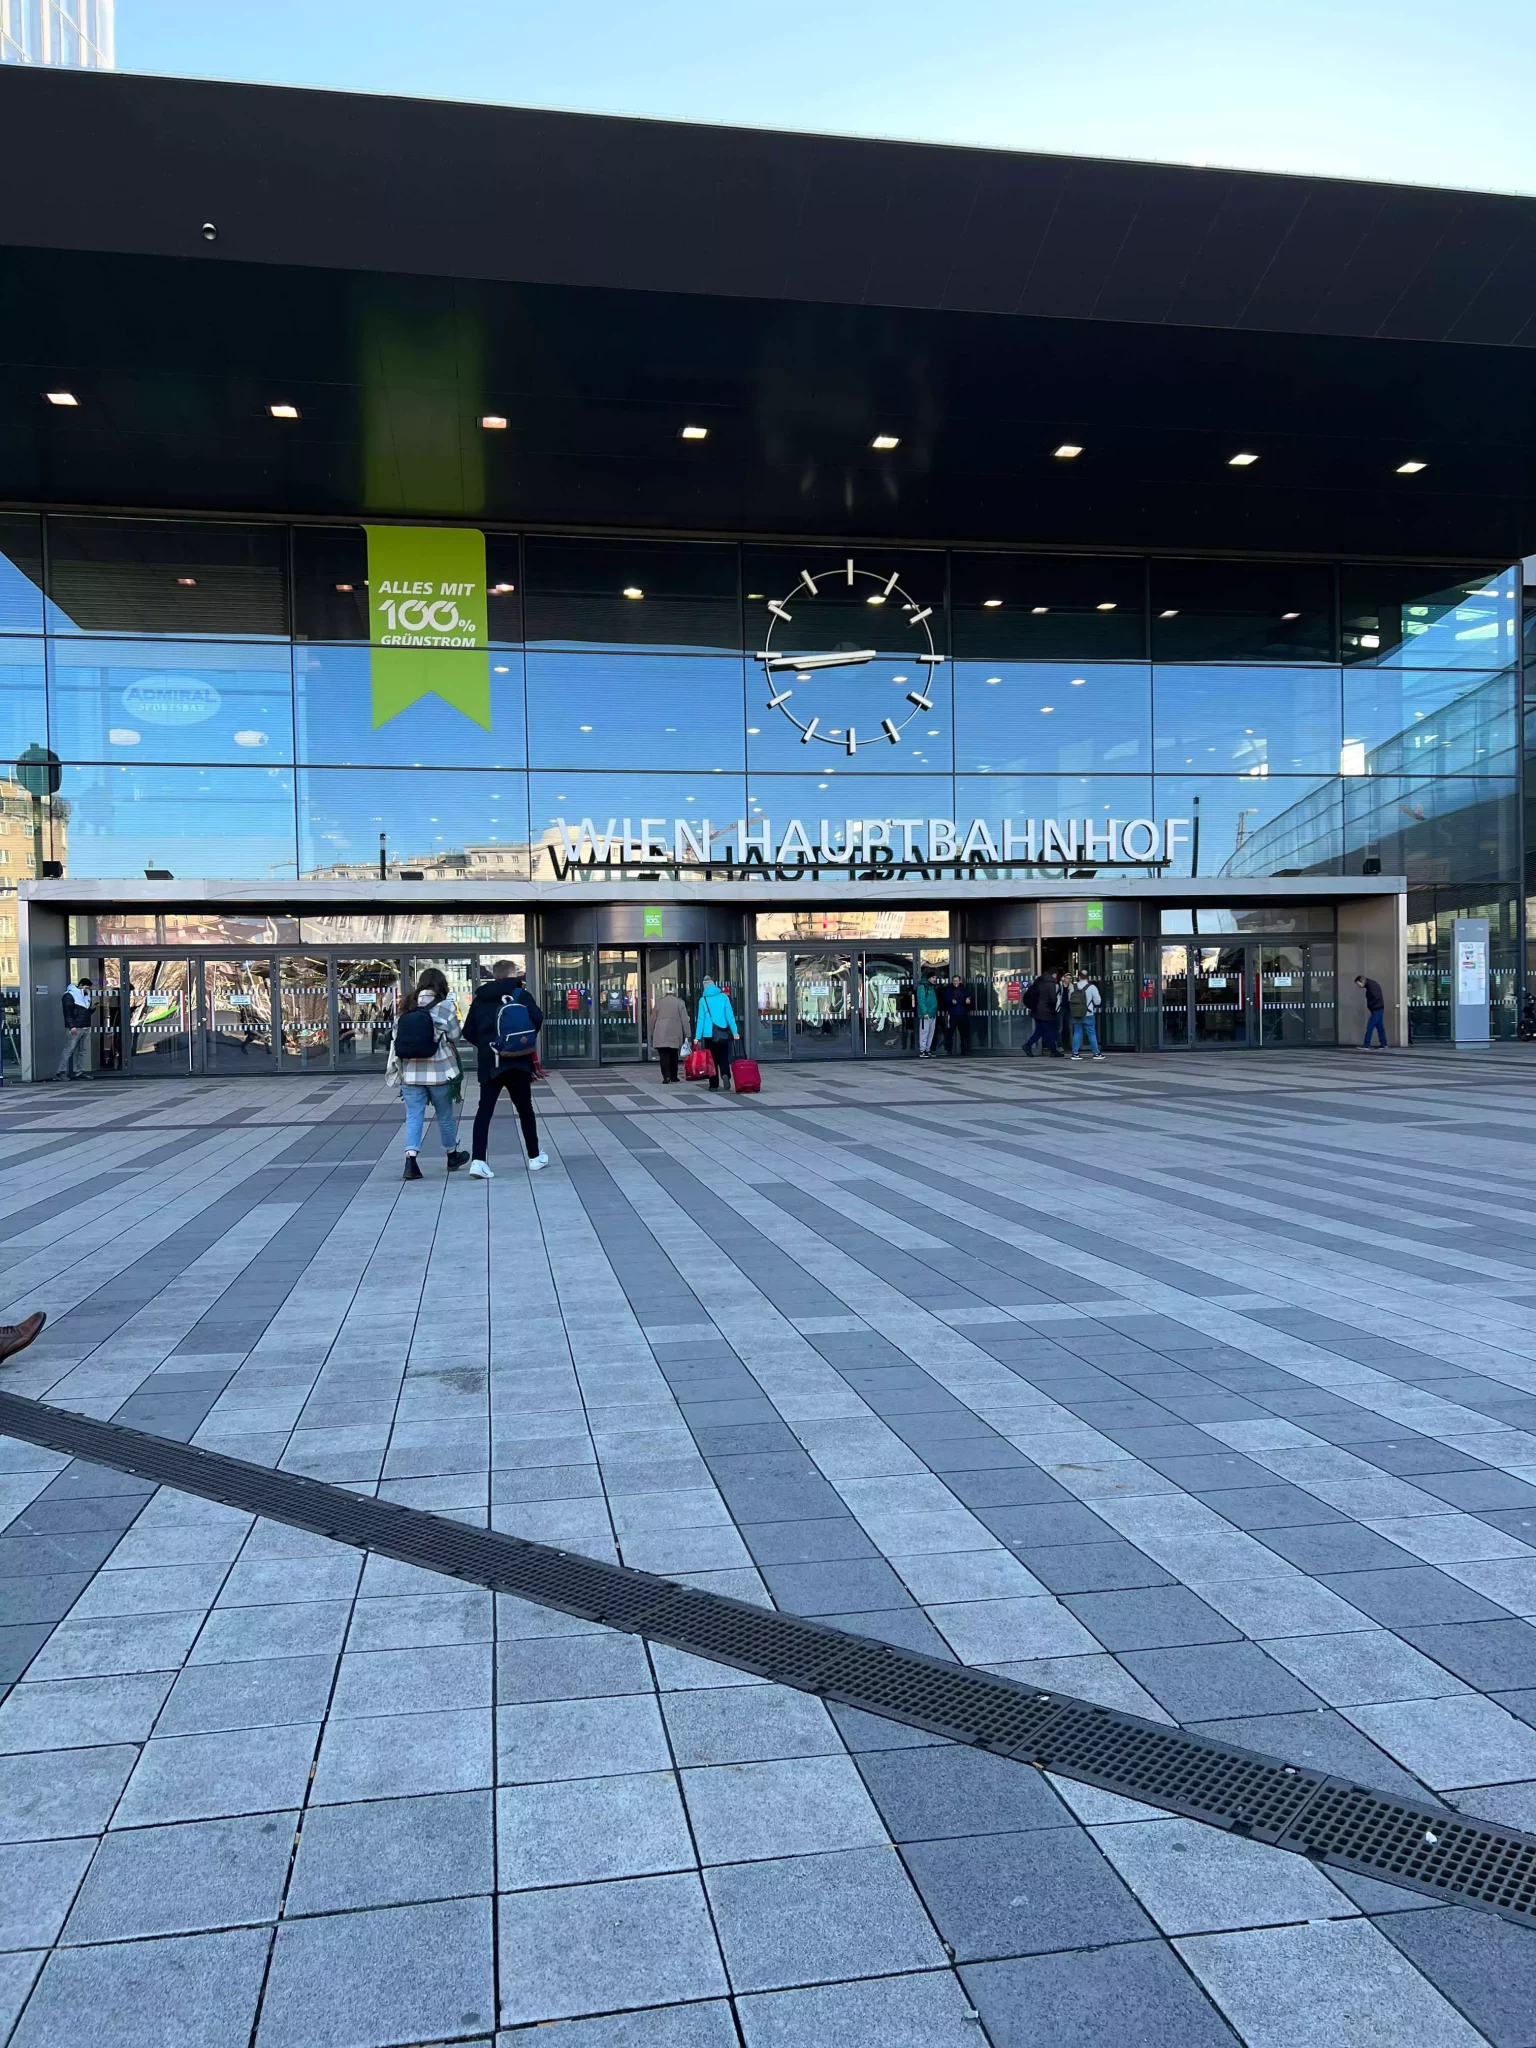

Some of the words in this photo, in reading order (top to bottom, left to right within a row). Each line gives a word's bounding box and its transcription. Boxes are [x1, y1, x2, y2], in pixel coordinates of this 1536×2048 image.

[379, 581, 433, 594] ALLES
[440, 583, 475, 596] MIT
[378, 600, 476, 632] 100%
[381, 633, 476, 647] GRÜNSTROM
[127, 687, 217, 703] ADMIRAL
[138, 703, 205, 712] SPORTSBAR
[557, 817, 712, 863] WIEN
[737, 818, 1189, 863] HAUPTBAHNHOF
